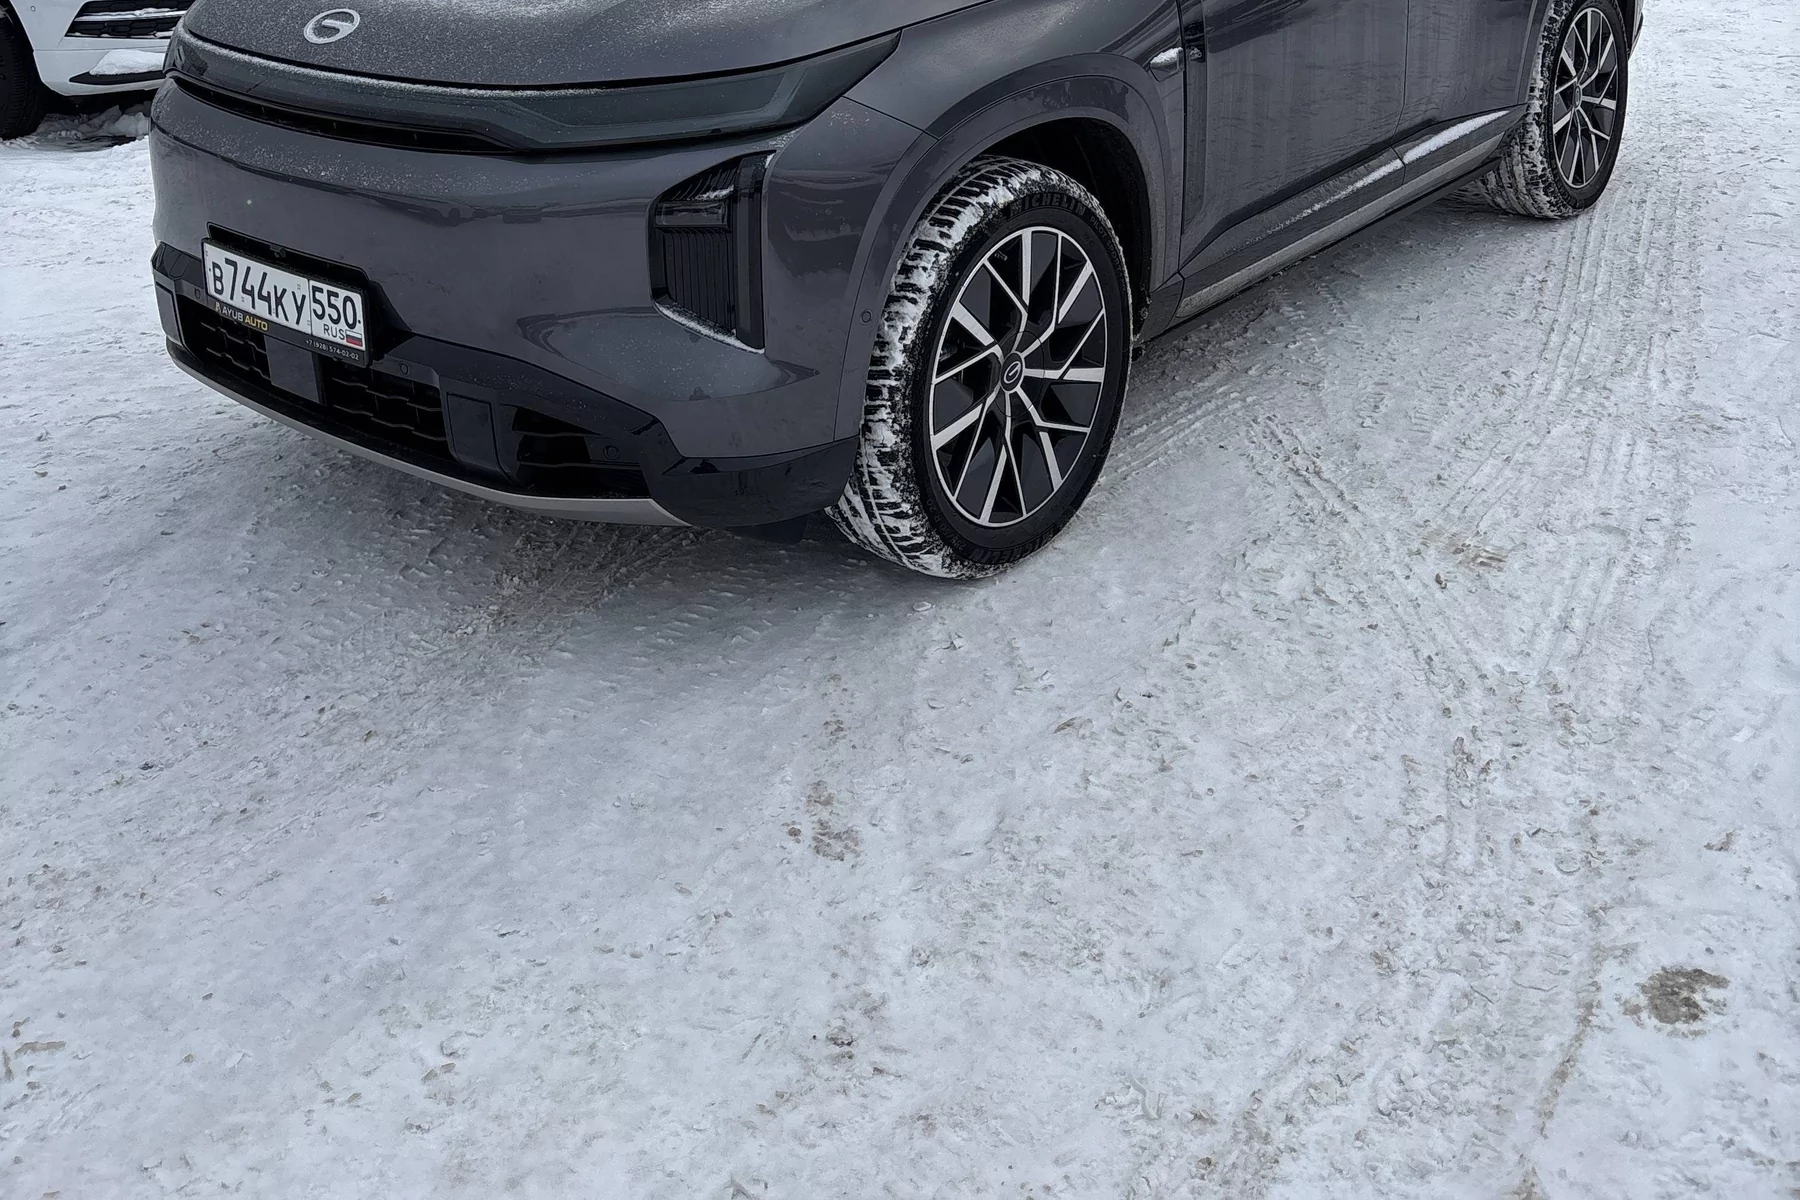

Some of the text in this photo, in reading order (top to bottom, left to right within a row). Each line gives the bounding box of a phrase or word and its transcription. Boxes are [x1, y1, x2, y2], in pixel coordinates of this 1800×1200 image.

[1010, 193, 1086, 218] MICHELIN
[222, 306, 268, 331] AYUB AUTO
[323, 323, 346, 341] RUS
